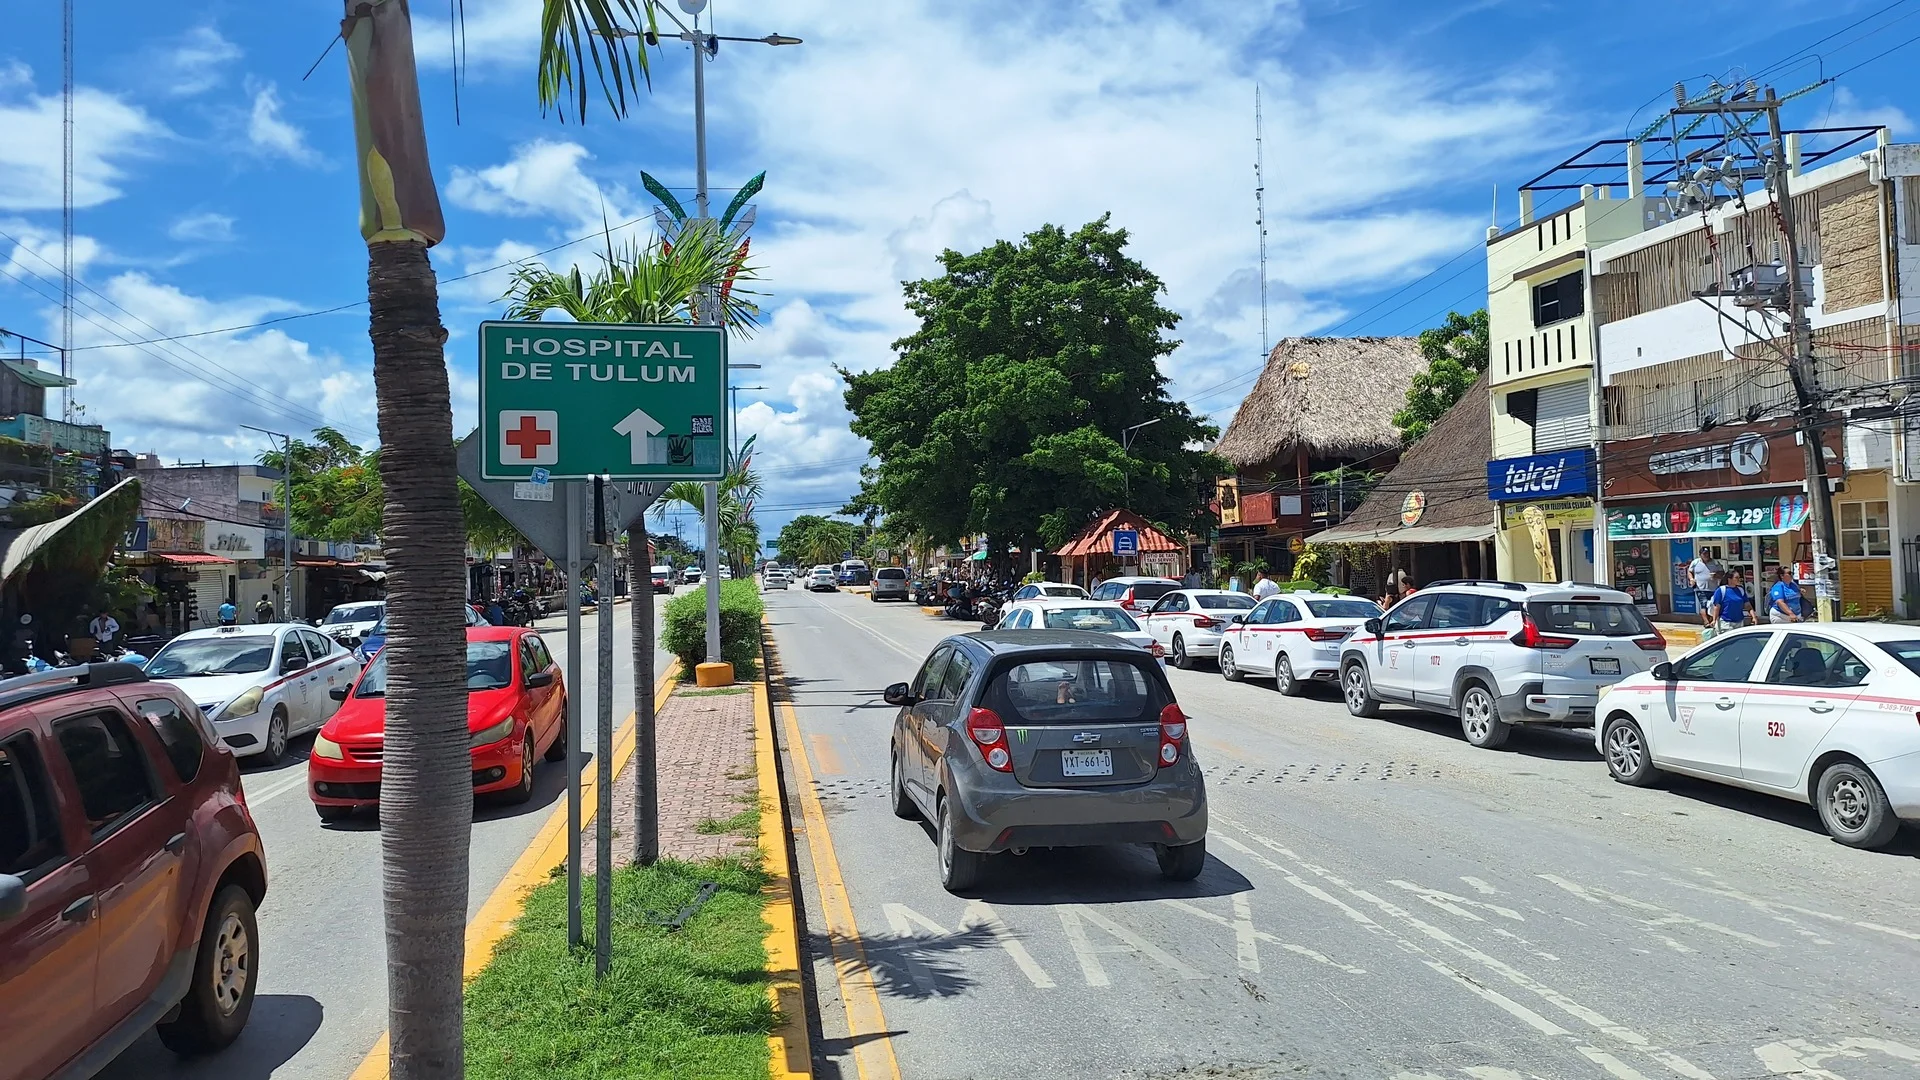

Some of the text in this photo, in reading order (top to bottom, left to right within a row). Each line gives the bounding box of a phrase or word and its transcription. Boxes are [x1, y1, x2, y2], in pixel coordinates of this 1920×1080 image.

[504, 337, 694, 359] HOSPITAL
[501, 362, 696, 383] DE TULUM
[1504, 458, 1566, 494] telcel
[1430, 655, 1441, 666] 1072
[1767, 721, 1786, 737] 529
[1064, 755, 1112, 768] YXT-661-D
